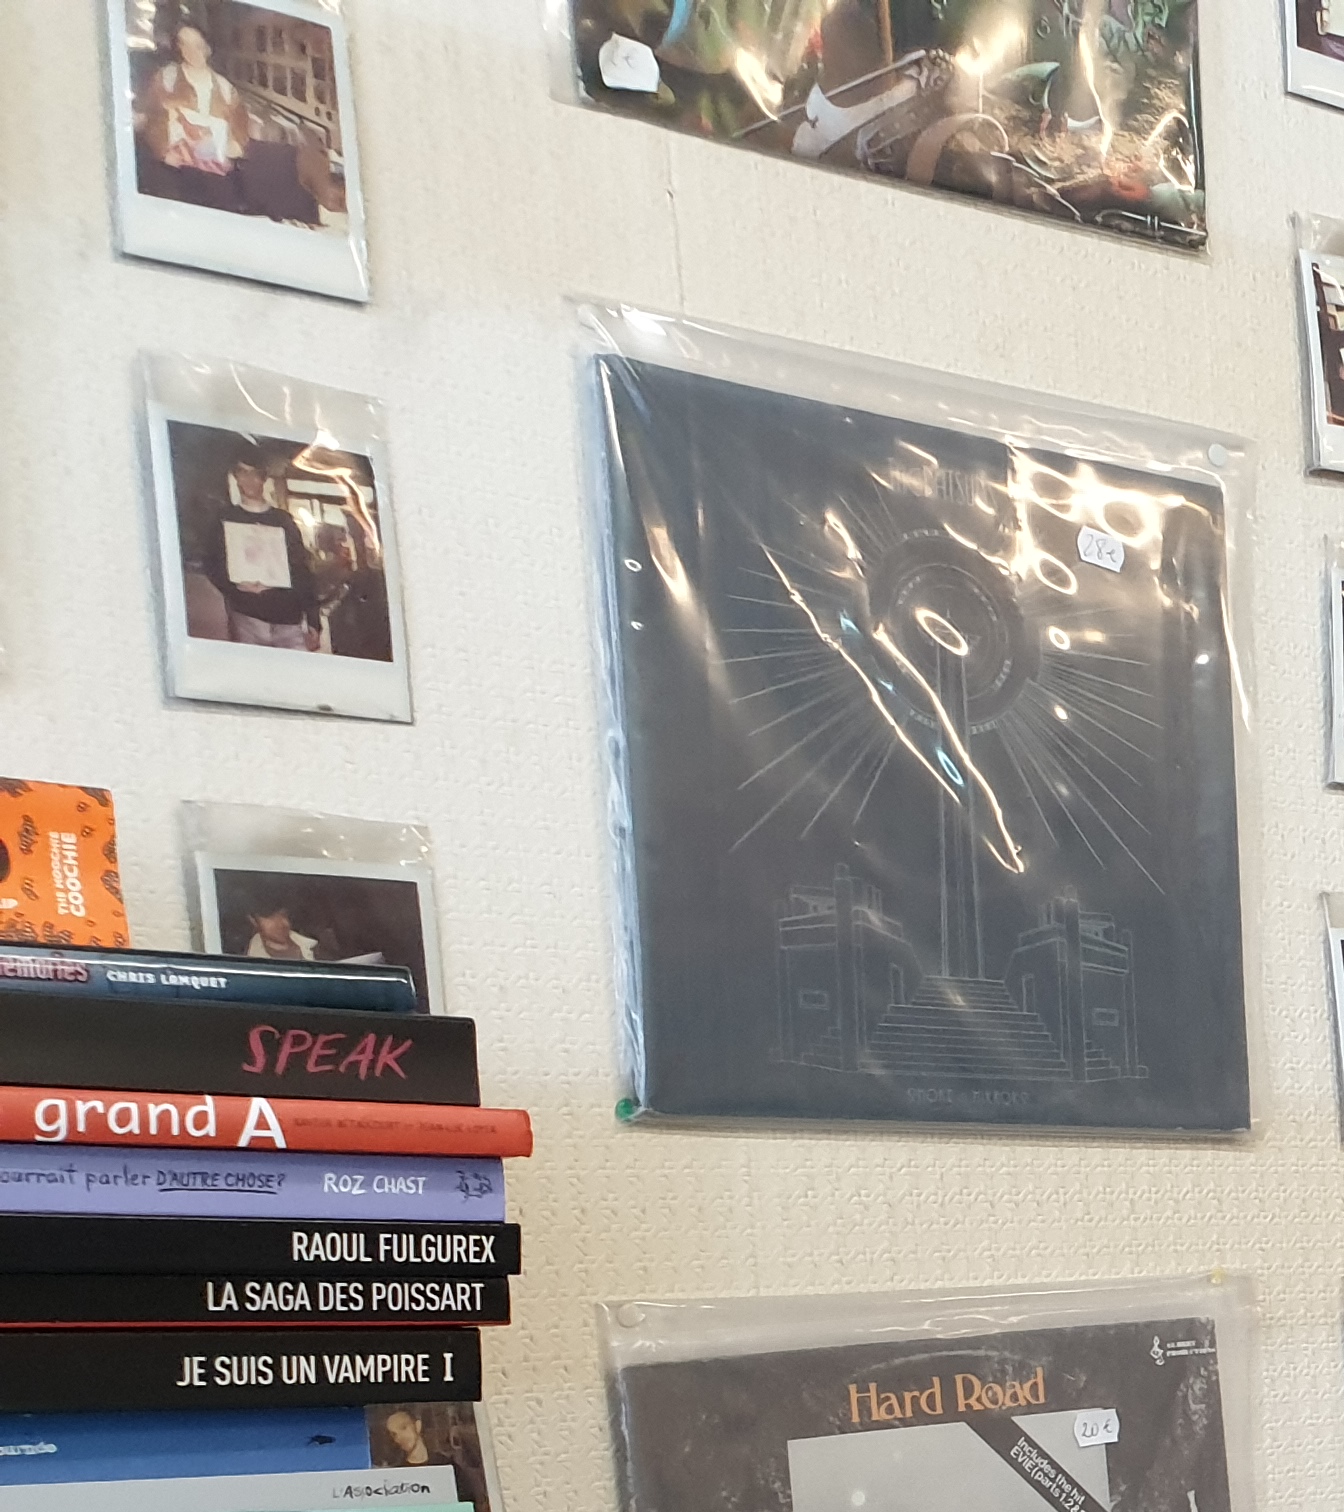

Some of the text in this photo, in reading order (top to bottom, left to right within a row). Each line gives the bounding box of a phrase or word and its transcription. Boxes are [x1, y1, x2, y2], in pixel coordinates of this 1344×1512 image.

[60, 832, 86, 917] COOCHIE
[241, 1025, 414, 1081] SPEAK
[34, 1094, 287, 1149] grand A
[85, 1164, 287, 1192] parler D'AUTRE CHOSE?
[324, 1173, 426, 1195] ROZ CHAST
[291, 1232, 495, 1264] RAOUL FULGUREX
[207, 1281, 484, 1312] LA SAGA DES POISSART
[177, 1352, 430, 1387] JE SUIS UN VAMPIRE
[849, 1366, 1045, 1423] Hard Road
[1009, 1446, 1034, 1472] EVIE
[1016, 1437, 1086, 1504] Includes the hit
